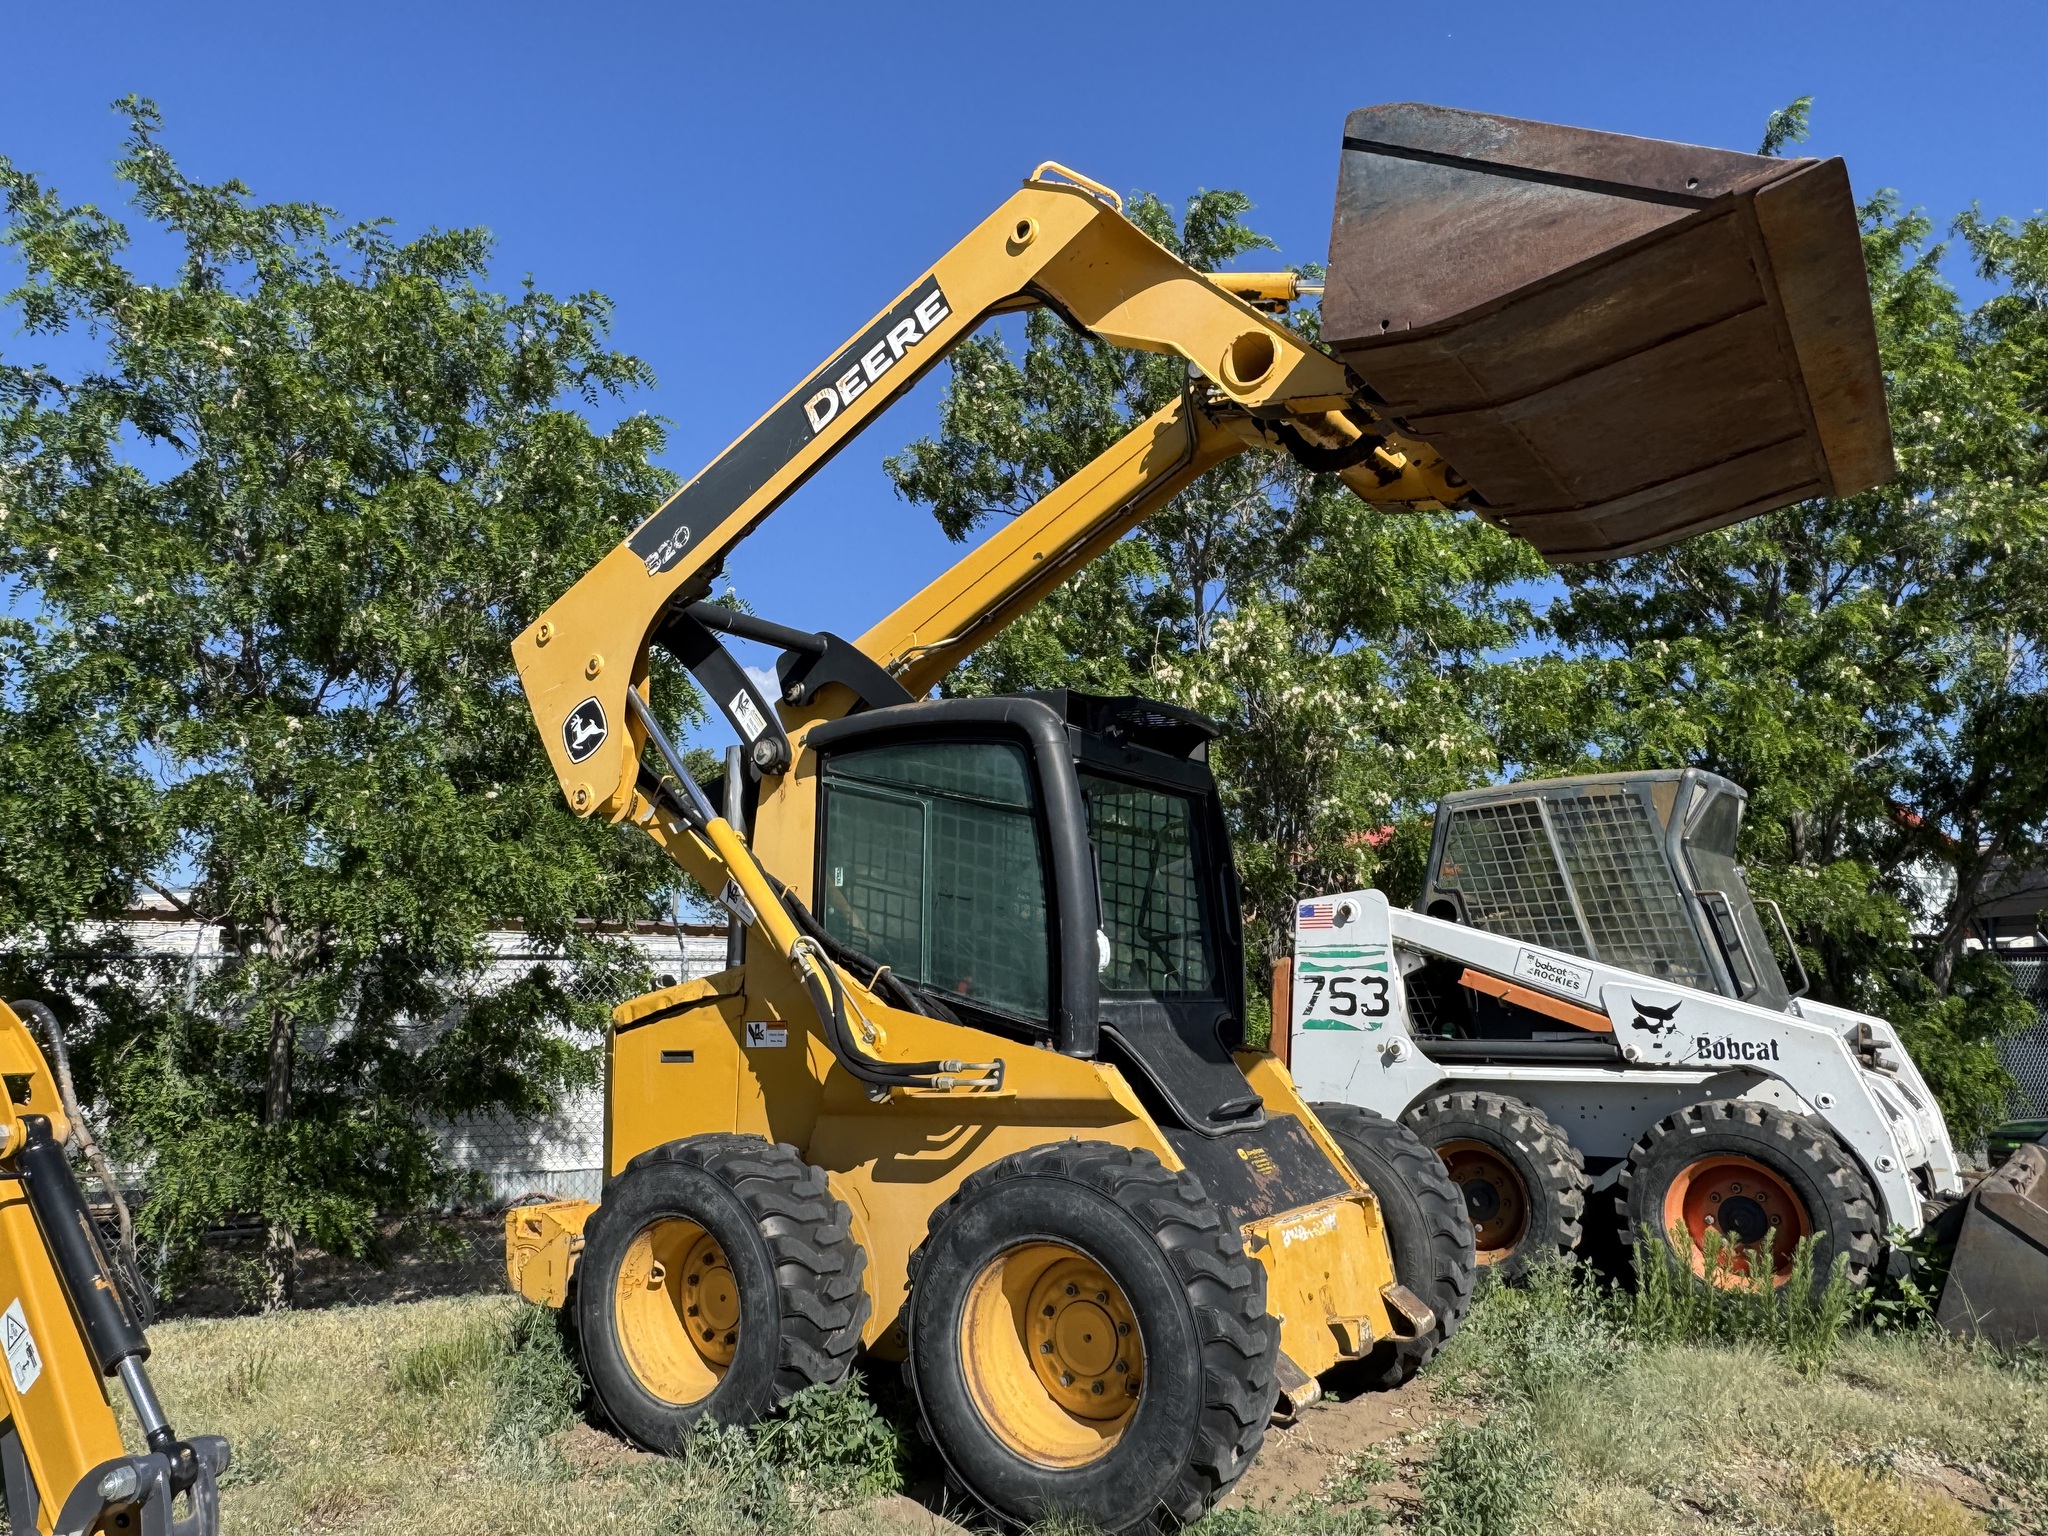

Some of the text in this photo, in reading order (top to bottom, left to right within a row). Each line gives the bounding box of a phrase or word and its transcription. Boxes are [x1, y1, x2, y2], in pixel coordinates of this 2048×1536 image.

[804, 289, 949, 434] DEERE
[644, 525, 690, 577] 320
[1533, 969, 1581, 990] ROCKIES
[1535, 958, 1568, 977] bobcat
[1299, 975, 1390, 1017] 753
[1696, 1027, 1780, 1061] Bobcat
